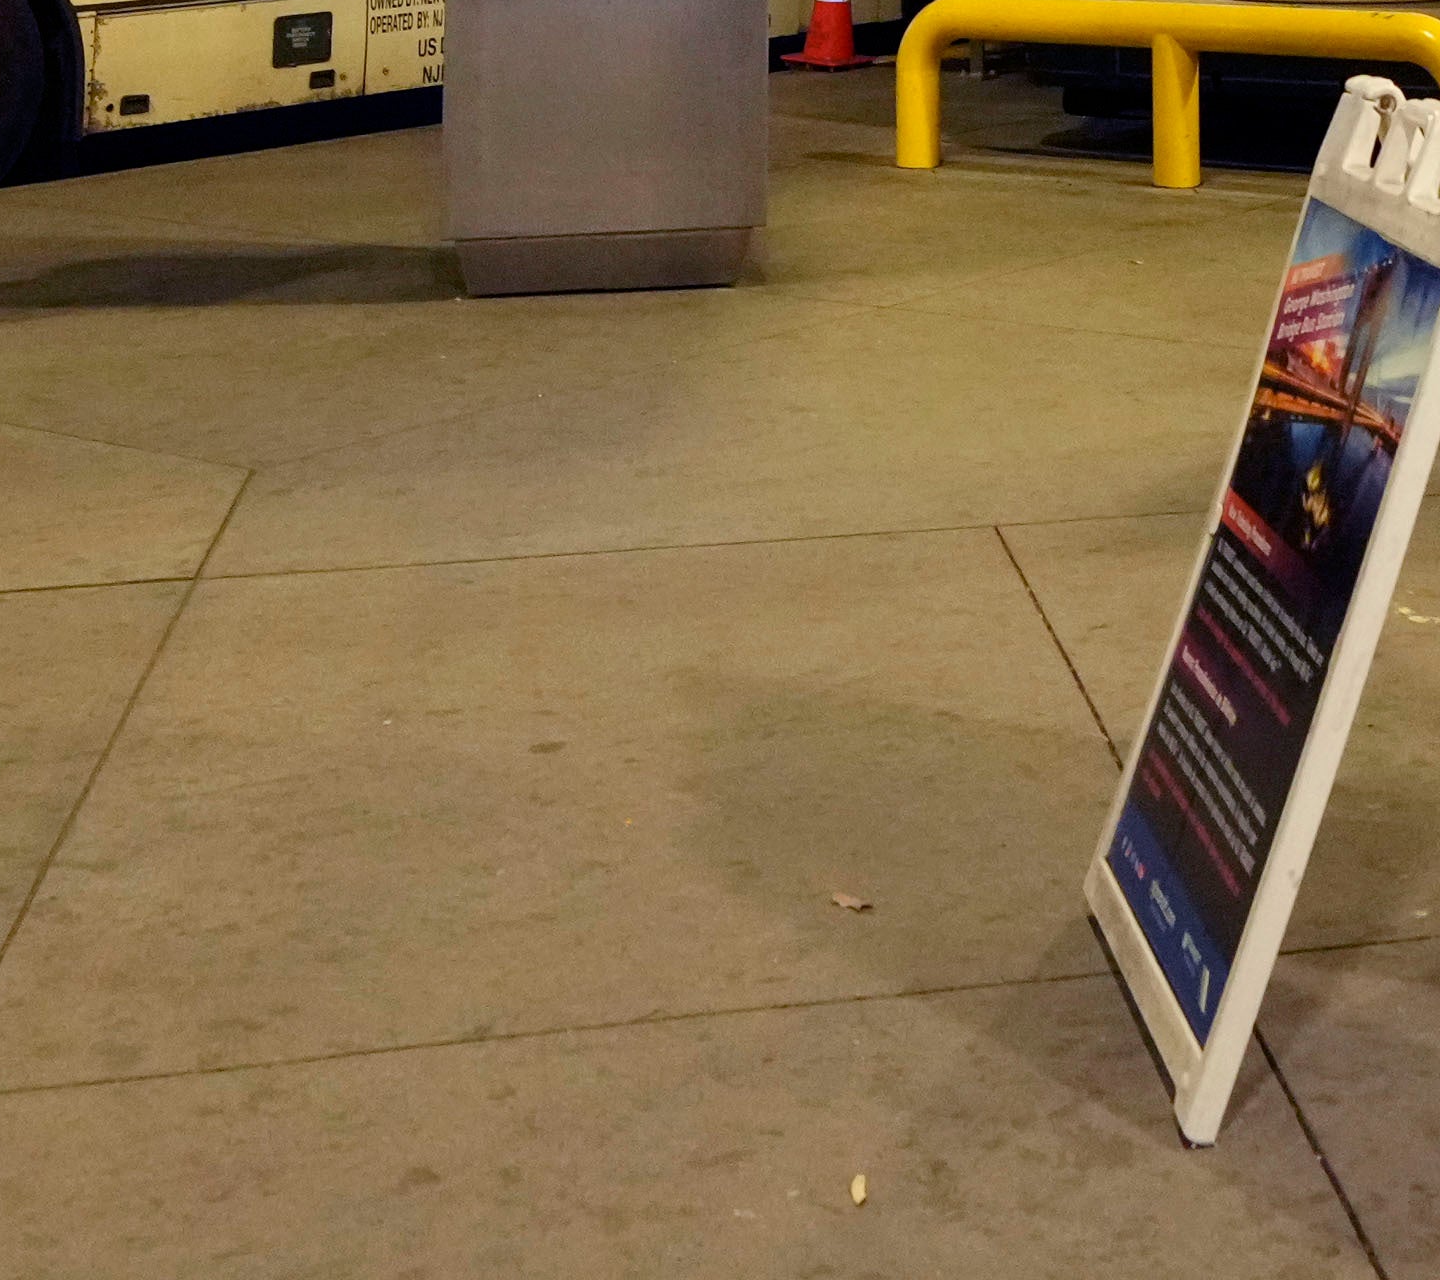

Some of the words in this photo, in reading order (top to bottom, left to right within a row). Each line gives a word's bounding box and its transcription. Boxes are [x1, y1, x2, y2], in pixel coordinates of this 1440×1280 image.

[370, 12, 413, 35] OPERATED
[416, 11, 430, 30] BY:
[418, 37, 437, 57] US
